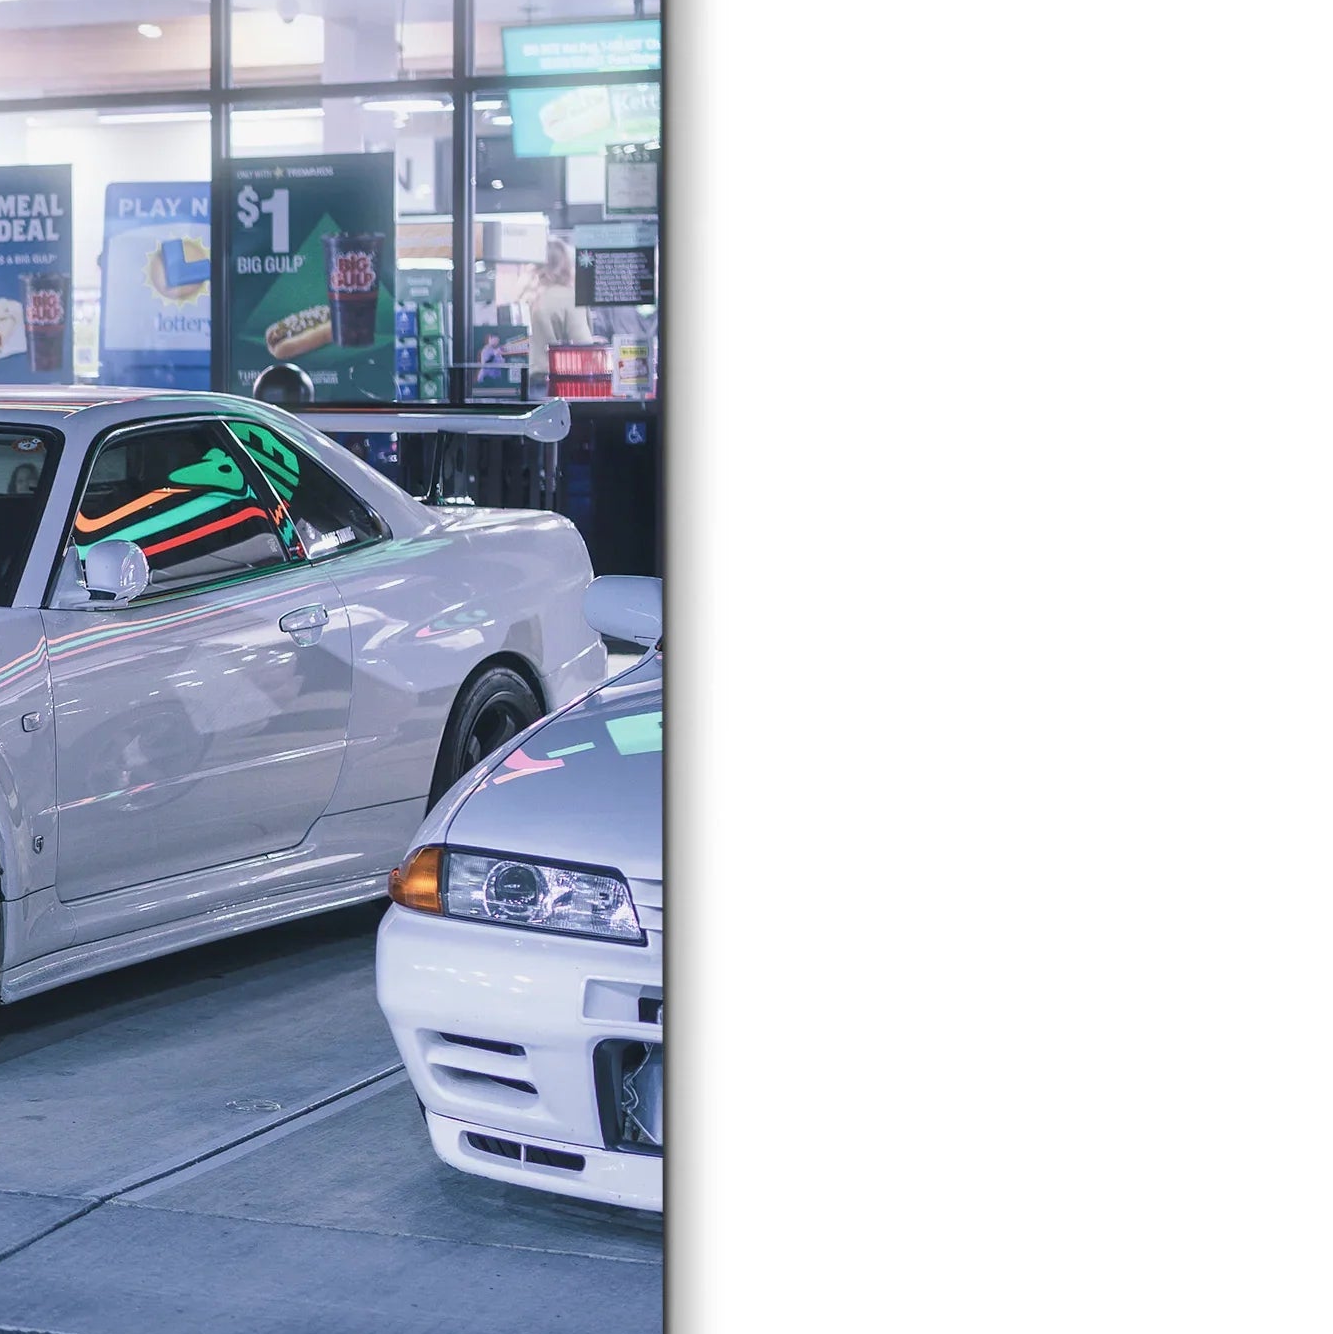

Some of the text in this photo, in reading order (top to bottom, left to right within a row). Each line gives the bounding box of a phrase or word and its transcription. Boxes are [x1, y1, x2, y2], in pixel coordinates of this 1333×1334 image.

[118, 197, 209, 219] PLAY N
[237, 185, 290, 254] $1
[236, 254, 305, 275] BIG GULP
[337, 255, 370, 273] BIG
[334, 271, 376, 288] GULP
